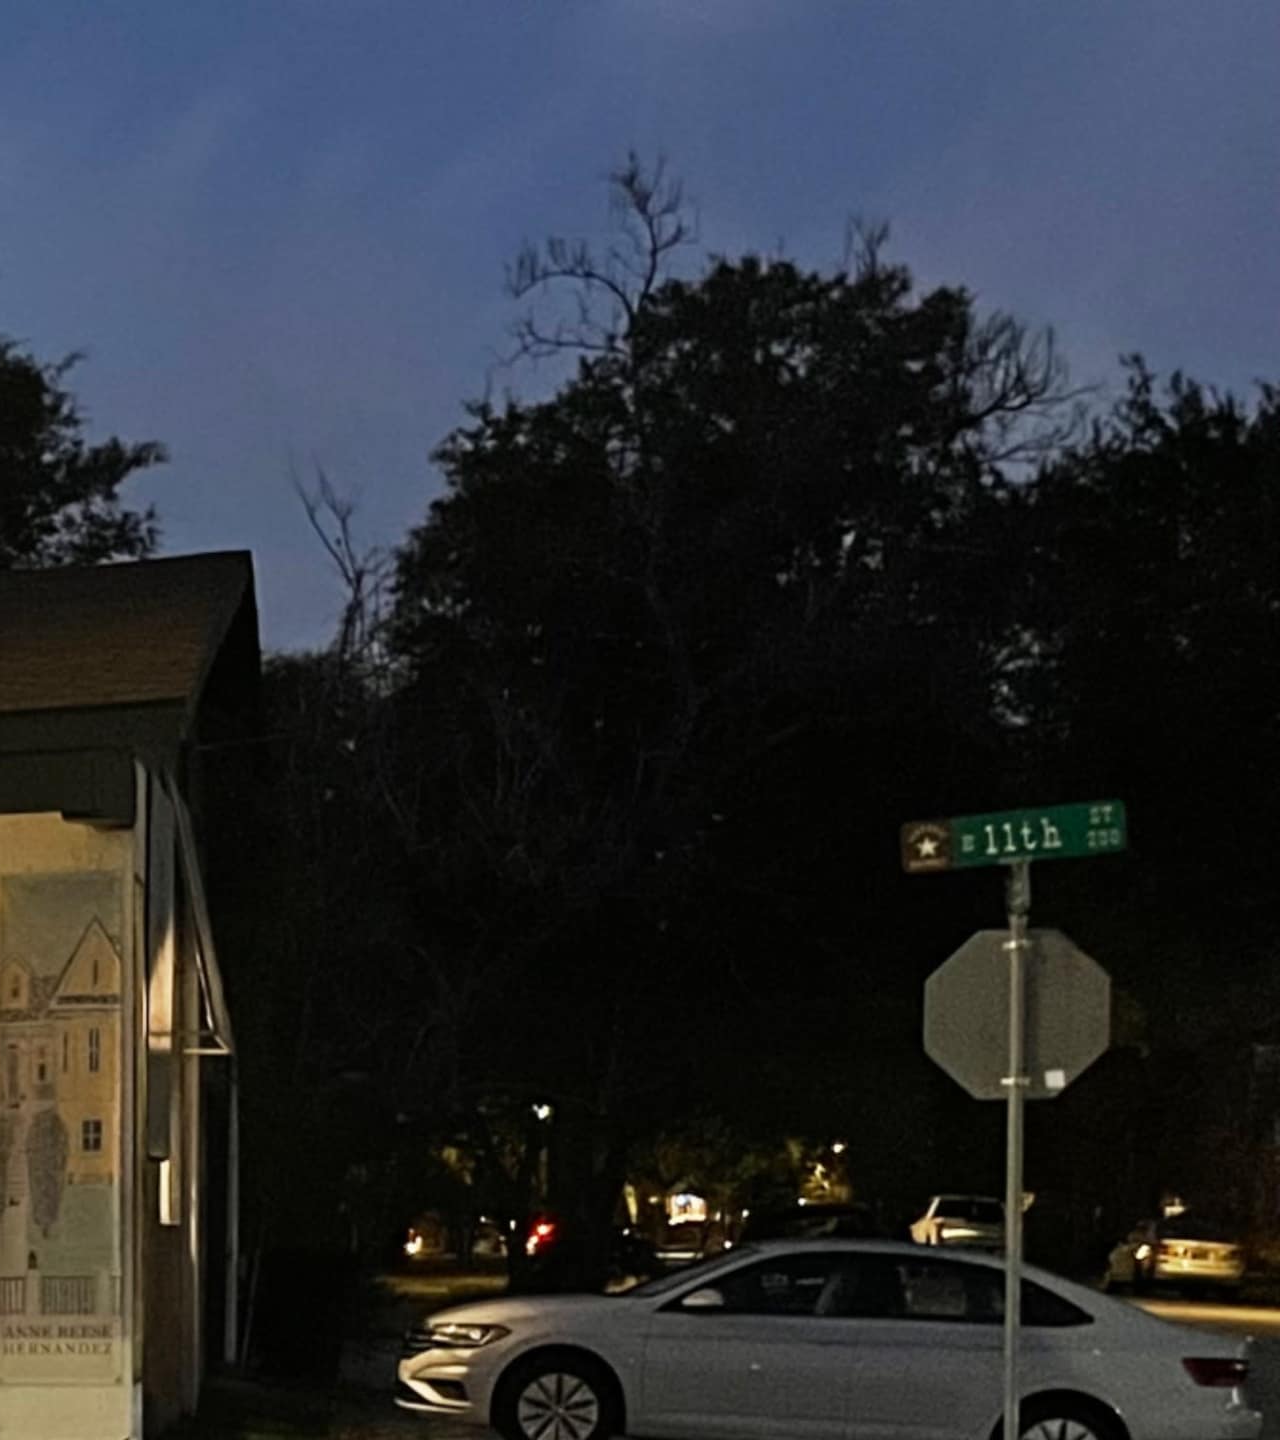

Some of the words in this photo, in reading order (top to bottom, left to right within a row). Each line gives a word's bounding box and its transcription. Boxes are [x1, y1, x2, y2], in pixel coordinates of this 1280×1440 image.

[984, 816, 1062, 855] 11th
[4, 1324, 50, 1338] ANNE
[2, 1342, 113, 1355] HERNANDEZ
